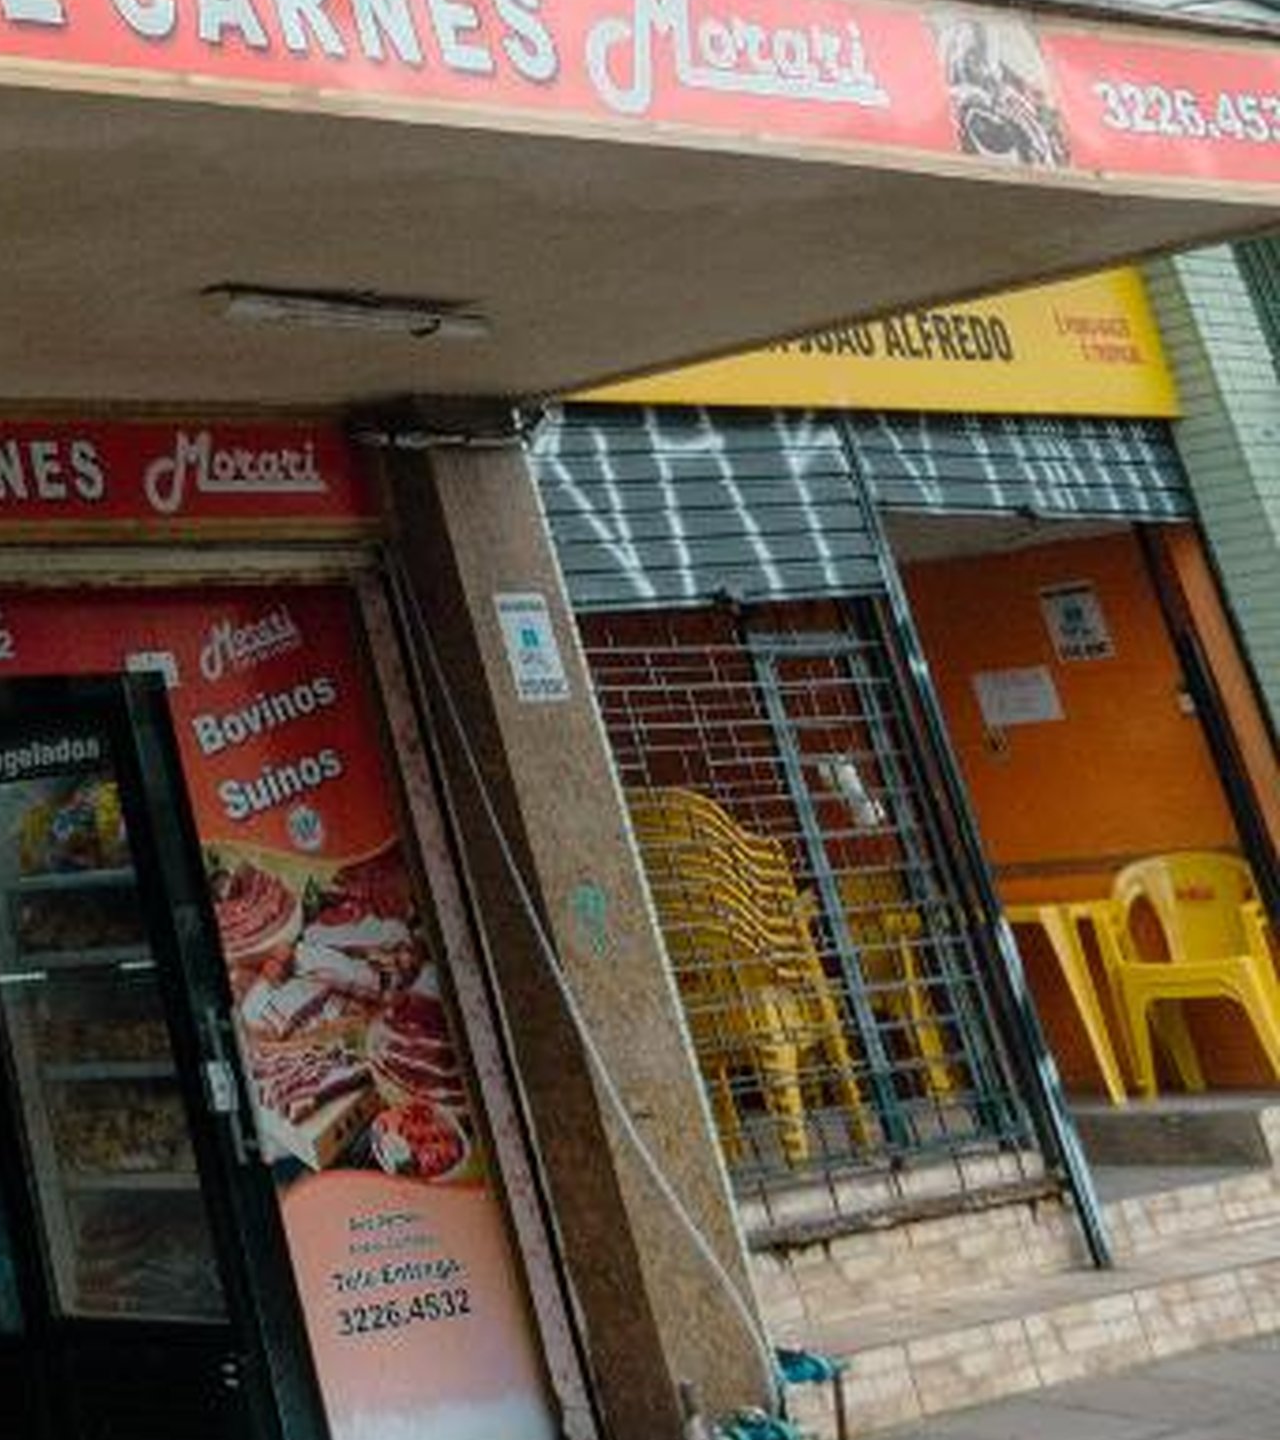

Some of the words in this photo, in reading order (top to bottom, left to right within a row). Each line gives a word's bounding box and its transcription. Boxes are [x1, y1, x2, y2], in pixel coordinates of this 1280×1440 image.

[886, 314, 1013, 362] ALFREDO
[143, 432, 325, 513] Morari
[192, 676, 337, 755] Bovinos
[218, 749, 343, 820] Suinos
[338, 1288, 471, 1336] 3226.4532
